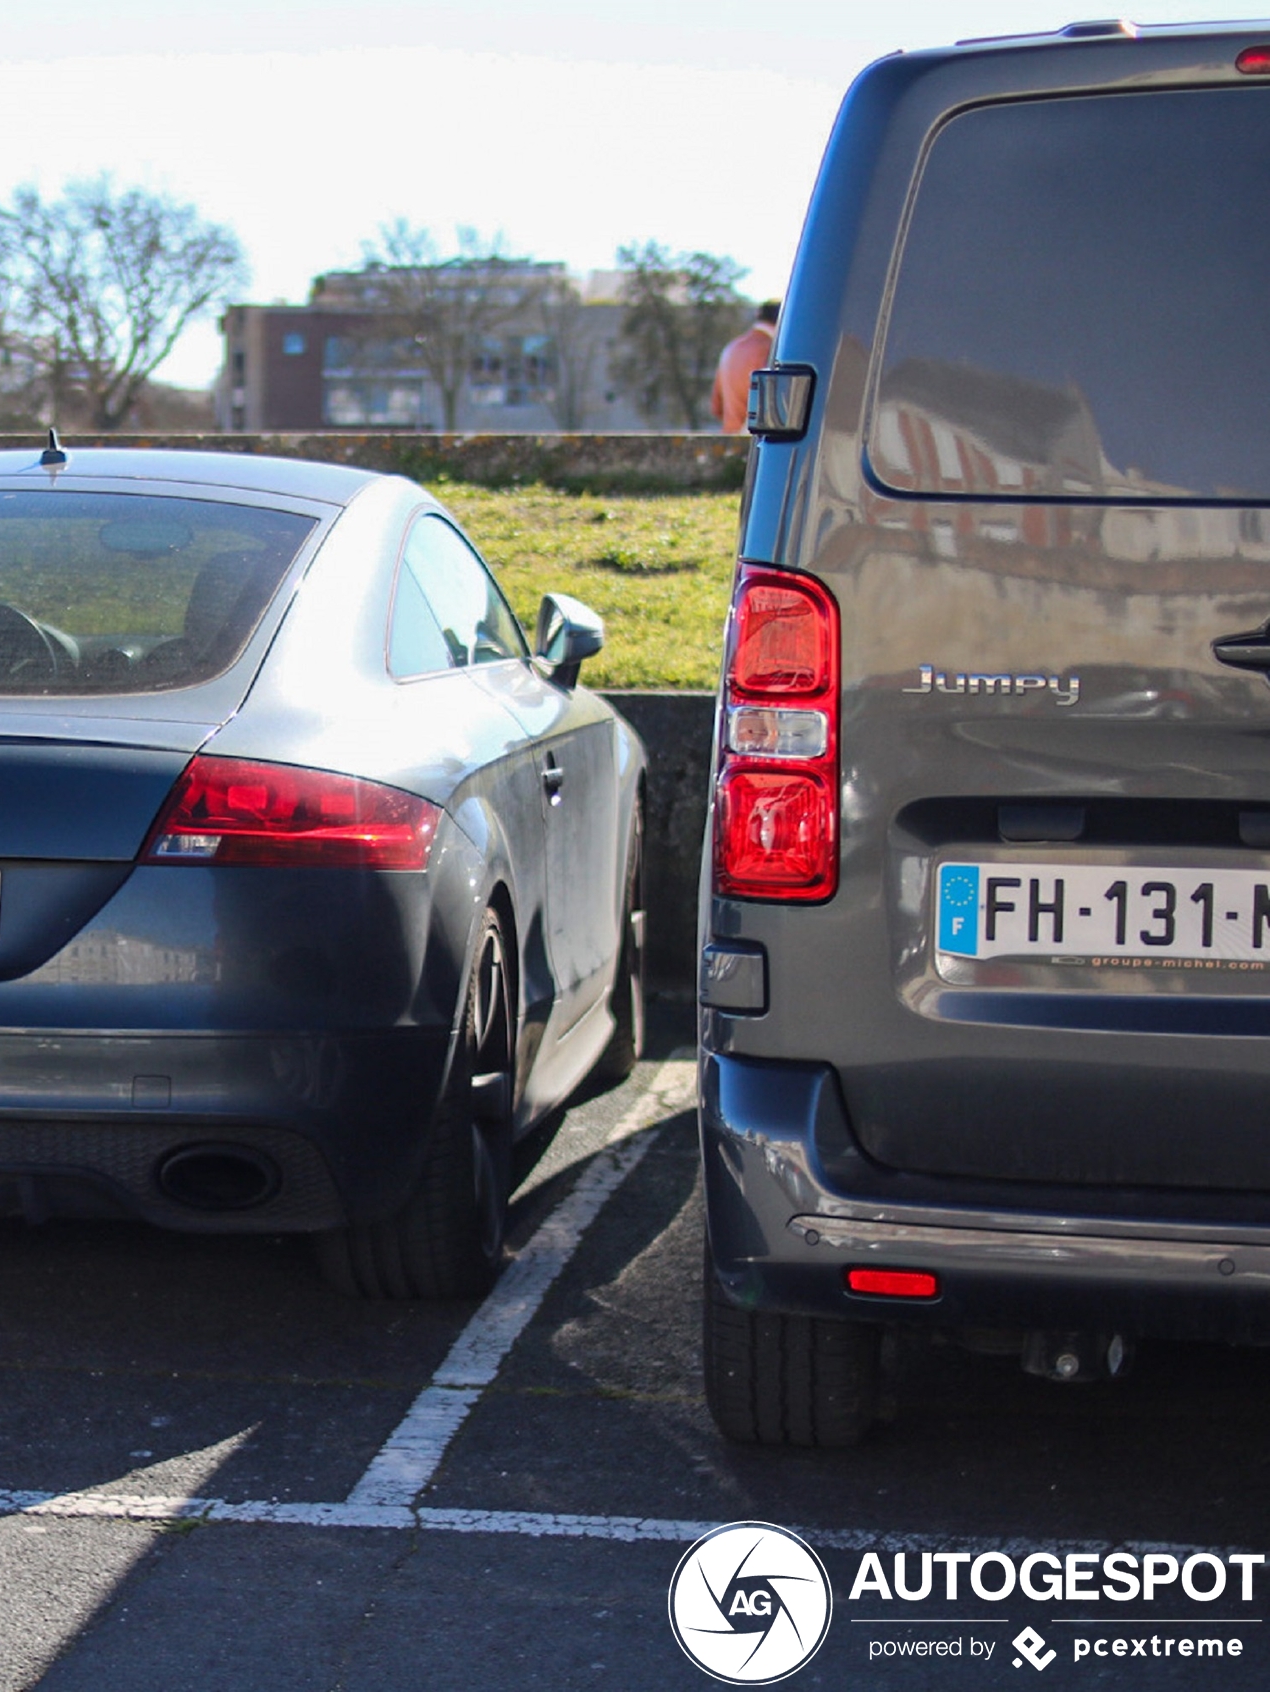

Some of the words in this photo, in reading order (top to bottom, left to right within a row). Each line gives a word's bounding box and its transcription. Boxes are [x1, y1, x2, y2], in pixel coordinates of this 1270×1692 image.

[902, 664, 1080, 706] Jumpy
[952, 917, 964, 935] F
[1091, 956, 1264, 970] groupe-michel.com
